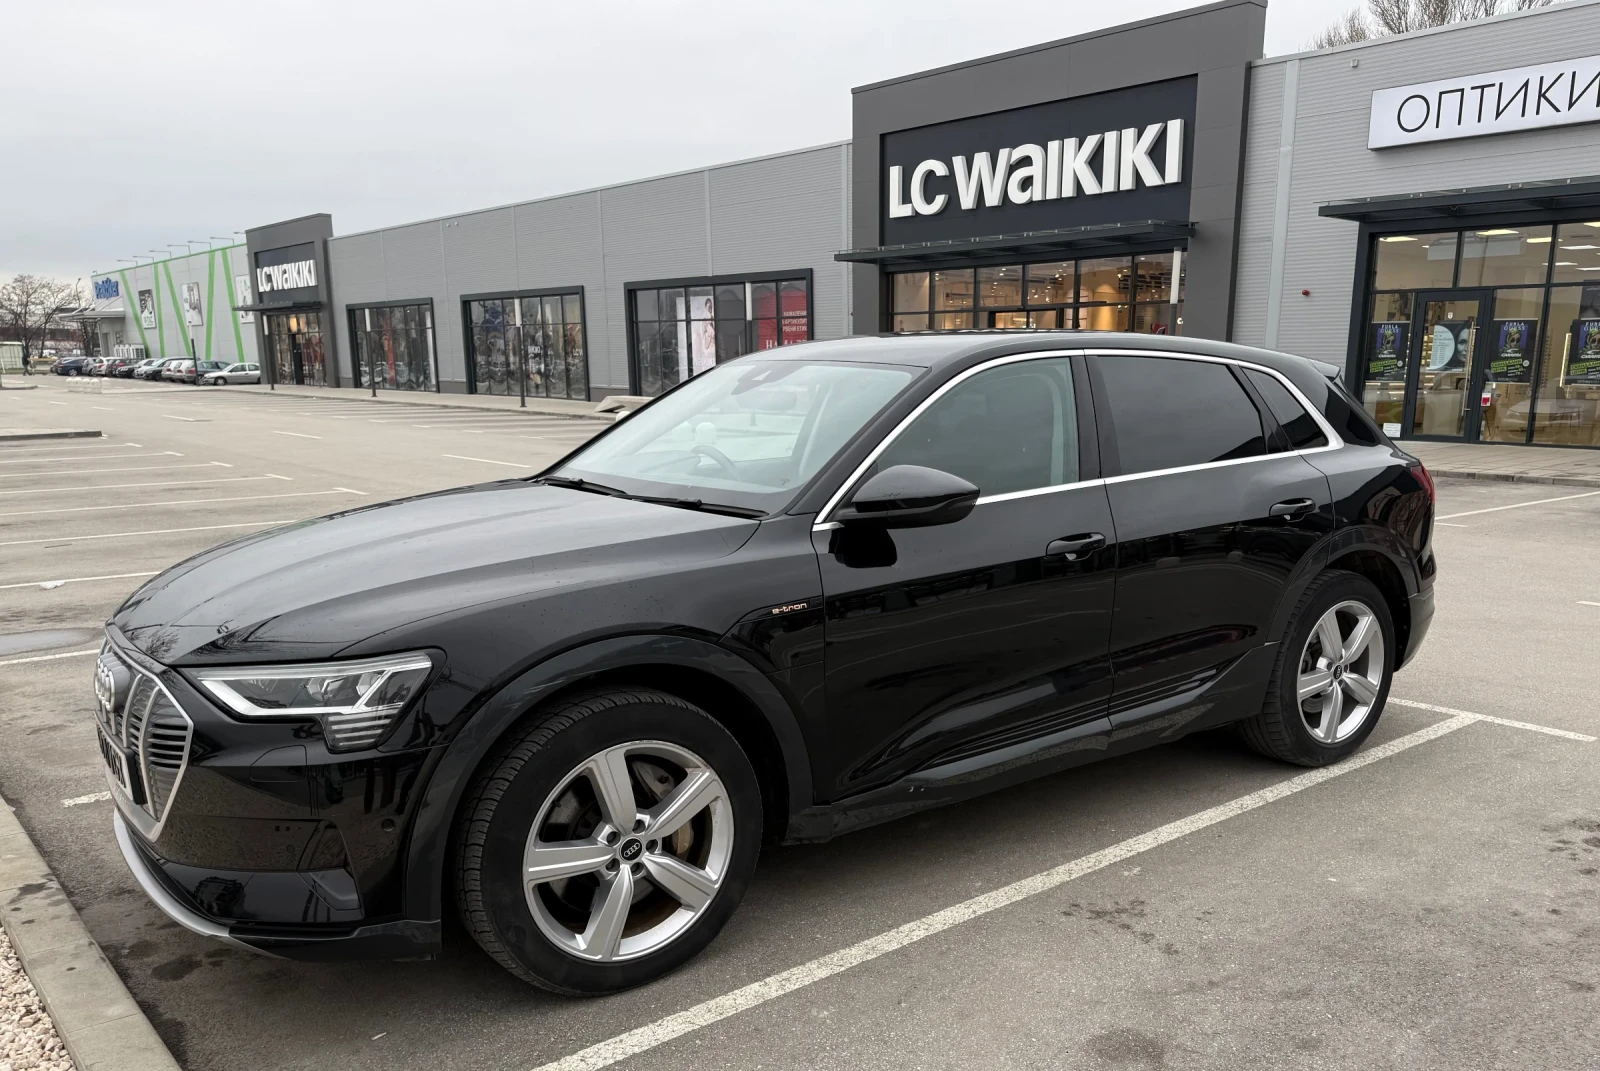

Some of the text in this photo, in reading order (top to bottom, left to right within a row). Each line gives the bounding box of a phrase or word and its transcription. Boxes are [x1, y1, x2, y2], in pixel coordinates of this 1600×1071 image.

[1397, 71, 1600, 133] ОПТИКИ
[889, 159, 949, 219] LC
[256, 266, 273, 293] LC
[772, 603, 807, 614] e-tron
